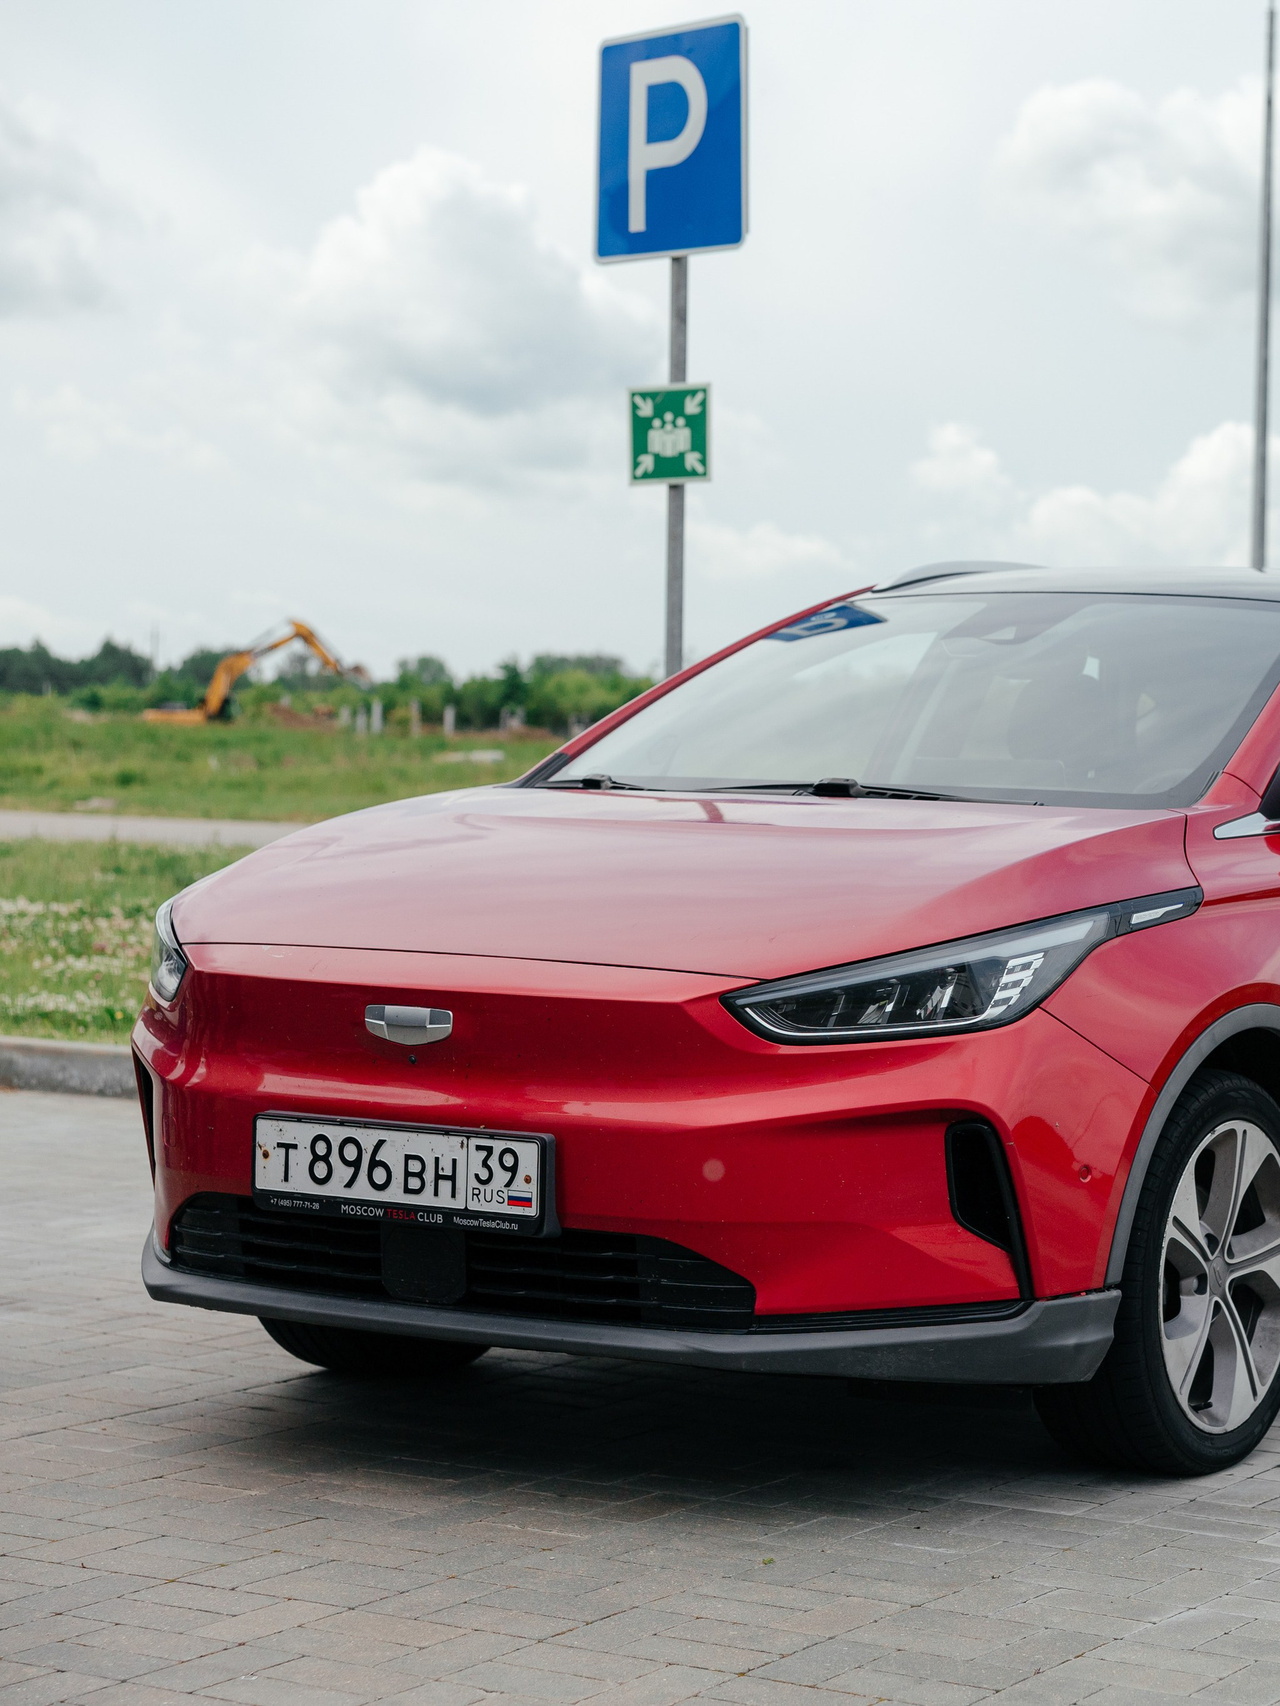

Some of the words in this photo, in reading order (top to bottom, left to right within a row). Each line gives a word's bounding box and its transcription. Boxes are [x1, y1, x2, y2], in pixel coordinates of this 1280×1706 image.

[628, 54, 708, 233] P
[474, 1144, 519, 1188] 39
[471, 1187, 505, 1205] RUS
[341, 1204, 385, 1217] MOSCOW
[386, 1208, 416, 1220] TESLA
[417, 1212, 444, 1224] CLUB
[453, 1216, 519, 1230] MoscowTeslaClub.ru
